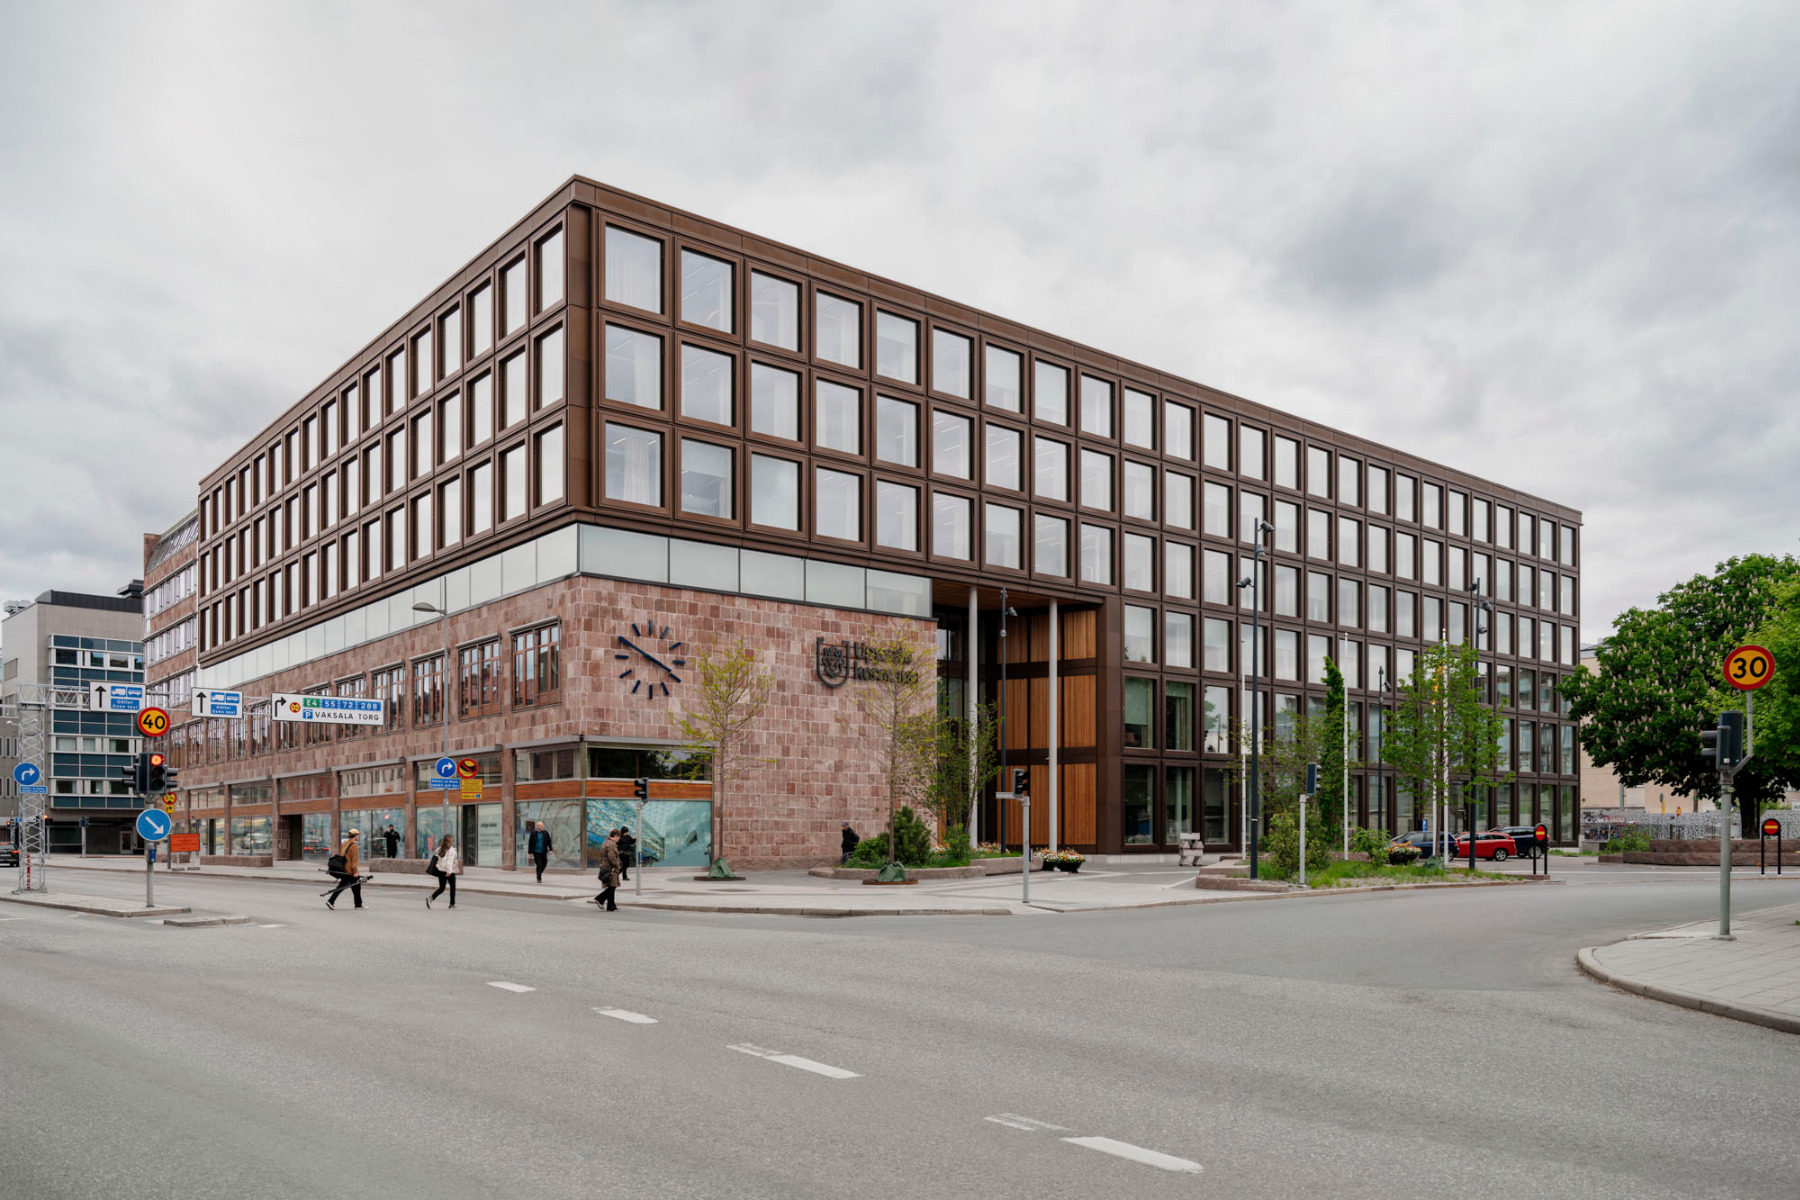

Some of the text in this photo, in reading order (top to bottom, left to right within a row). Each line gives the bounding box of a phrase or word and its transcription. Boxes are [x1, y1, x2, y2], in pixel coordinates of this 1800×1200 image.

[1733, 656, 1767, 679] 30
[306, 699, 318, 707] E4
[324, 700, 336, 708] 55
[143, 714, 165, 729] 40
[314, 711, 354, 720] VAKSALA
[358, 713, 379, 721] TORG
